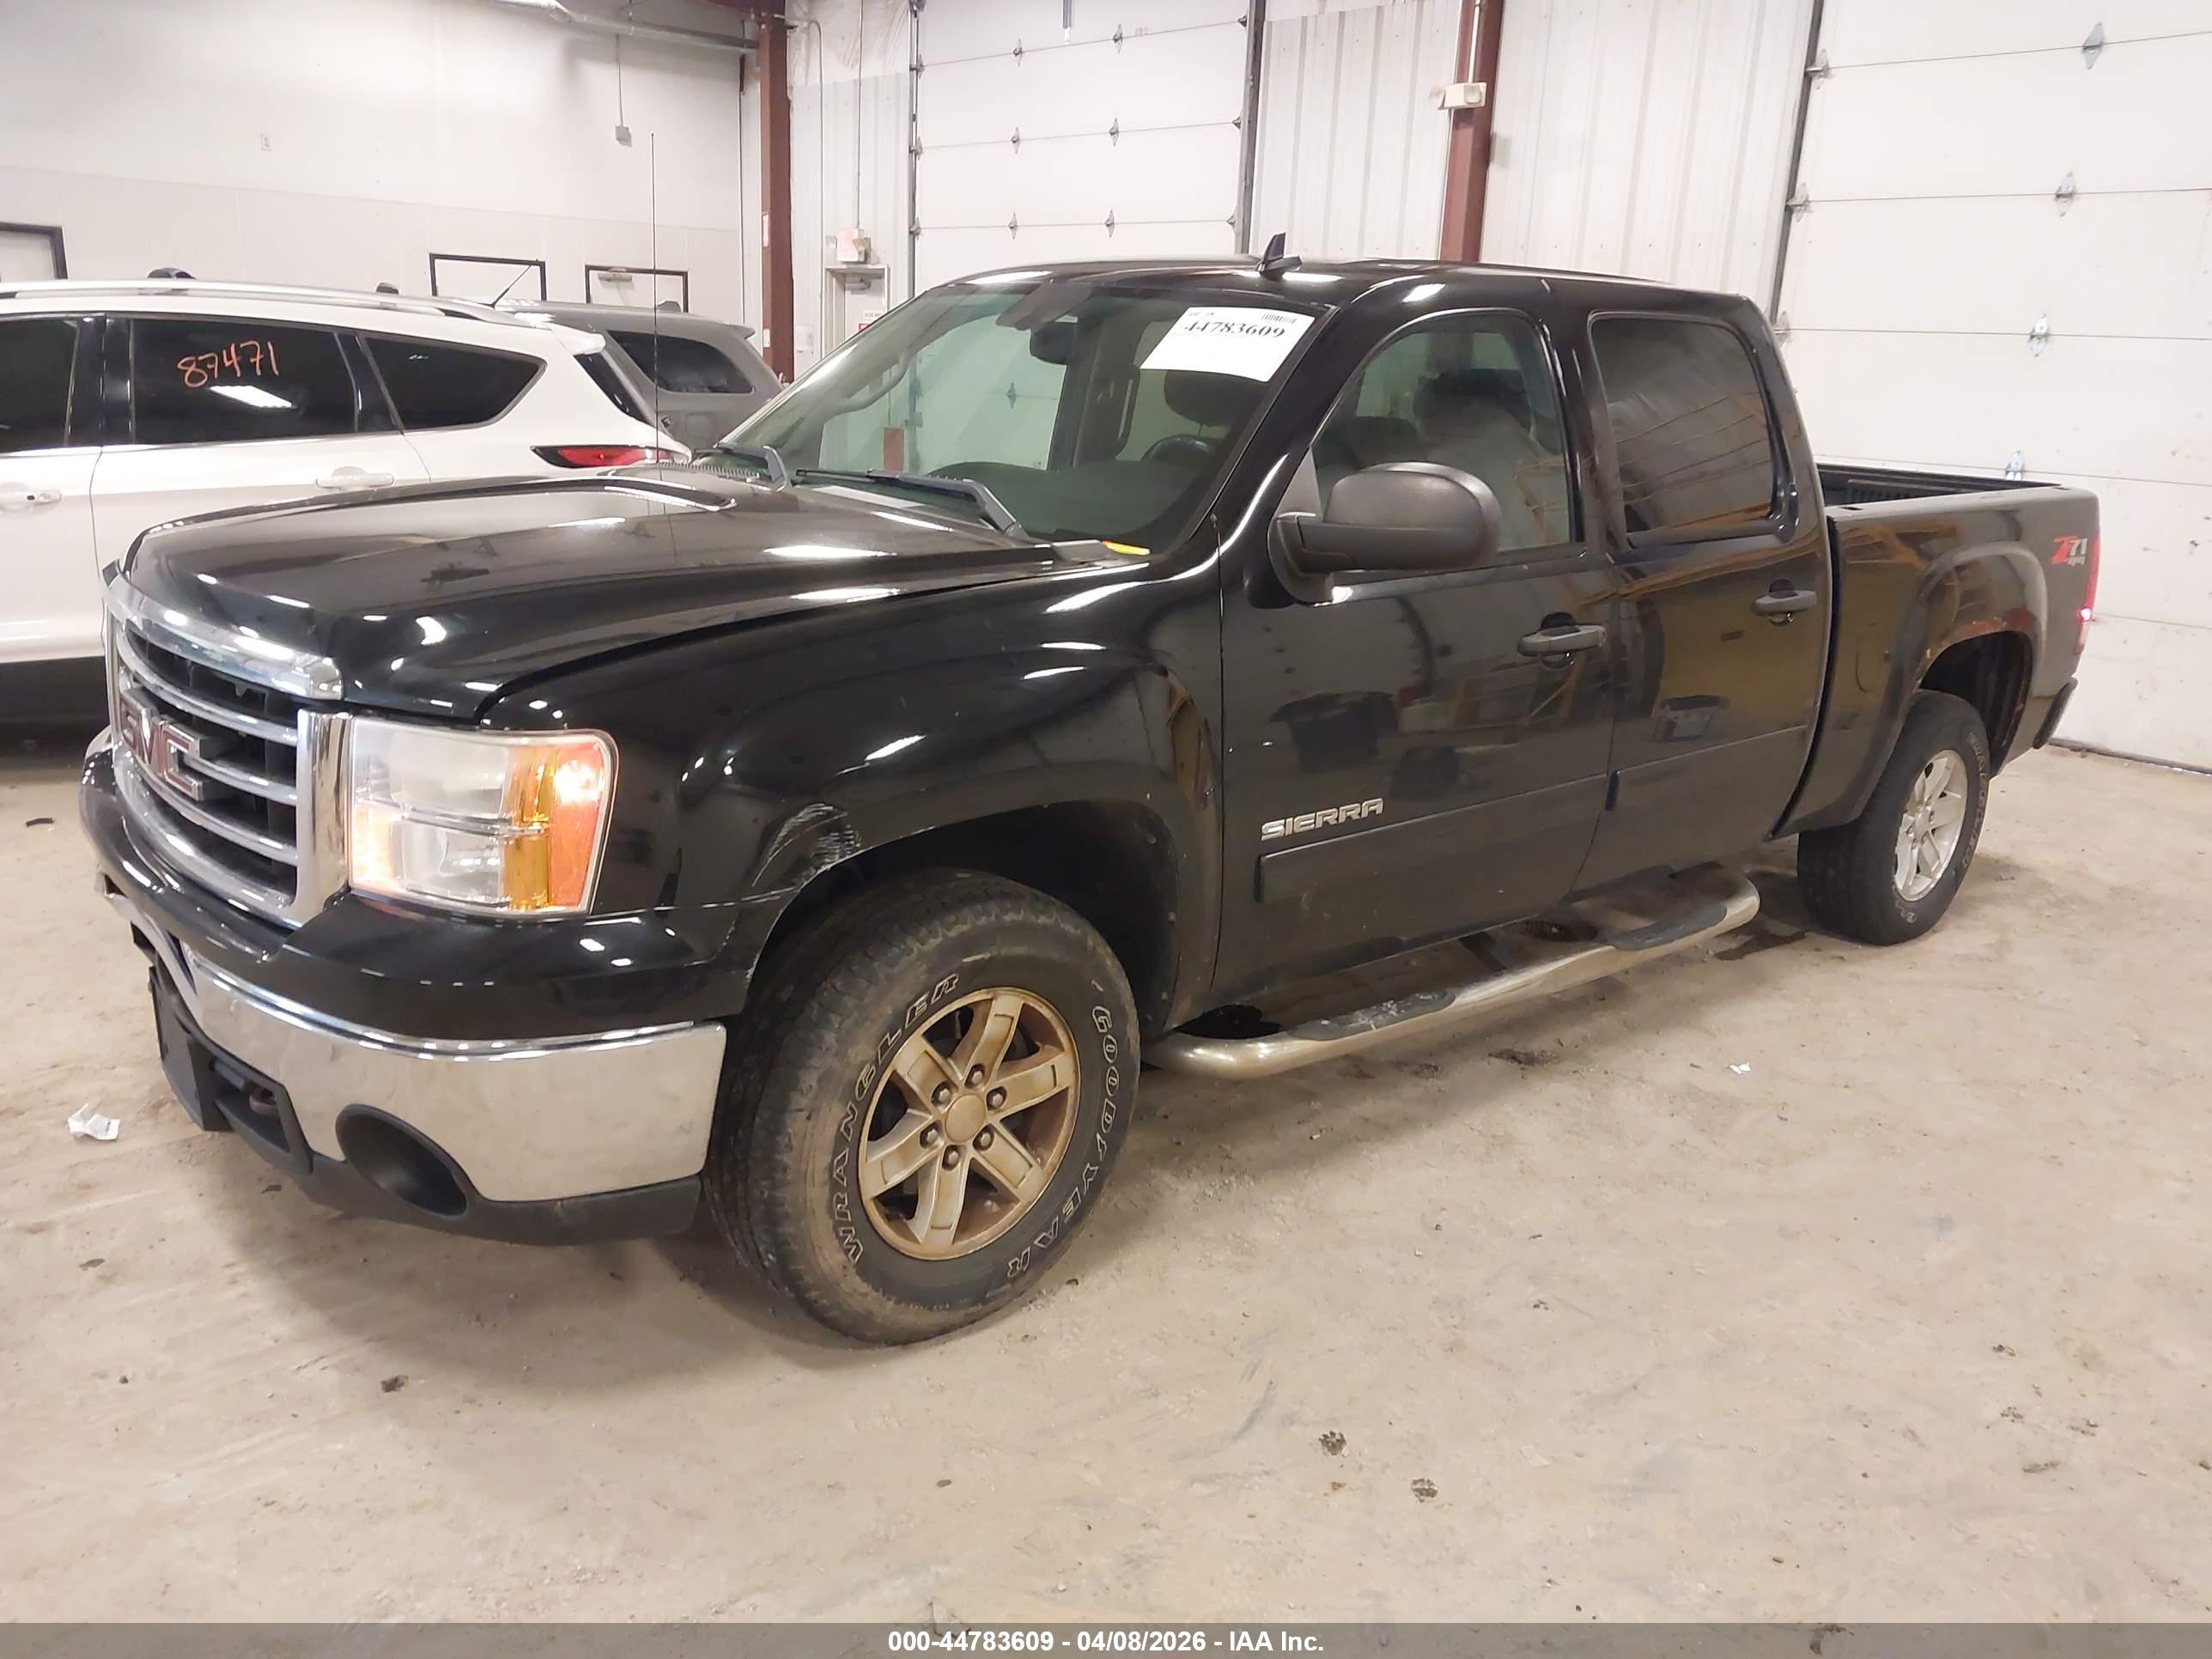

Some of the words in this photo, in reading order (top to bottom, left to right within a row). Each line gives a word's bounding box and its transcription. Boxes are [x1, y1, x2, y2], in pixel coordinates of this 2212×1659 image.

[1183, 321, 1285, 337] 44783609
[177, 340, 279, 387] 87471
[2051, 536, 2087, 564] Z71
[120, 689, 205, 801] GMC
[1261, 798, 1384, 841] SIERRA
[832, 973, 959, 1264] WRANGLER
[1006, 1006, 1119, 1278] GOODYEAR
